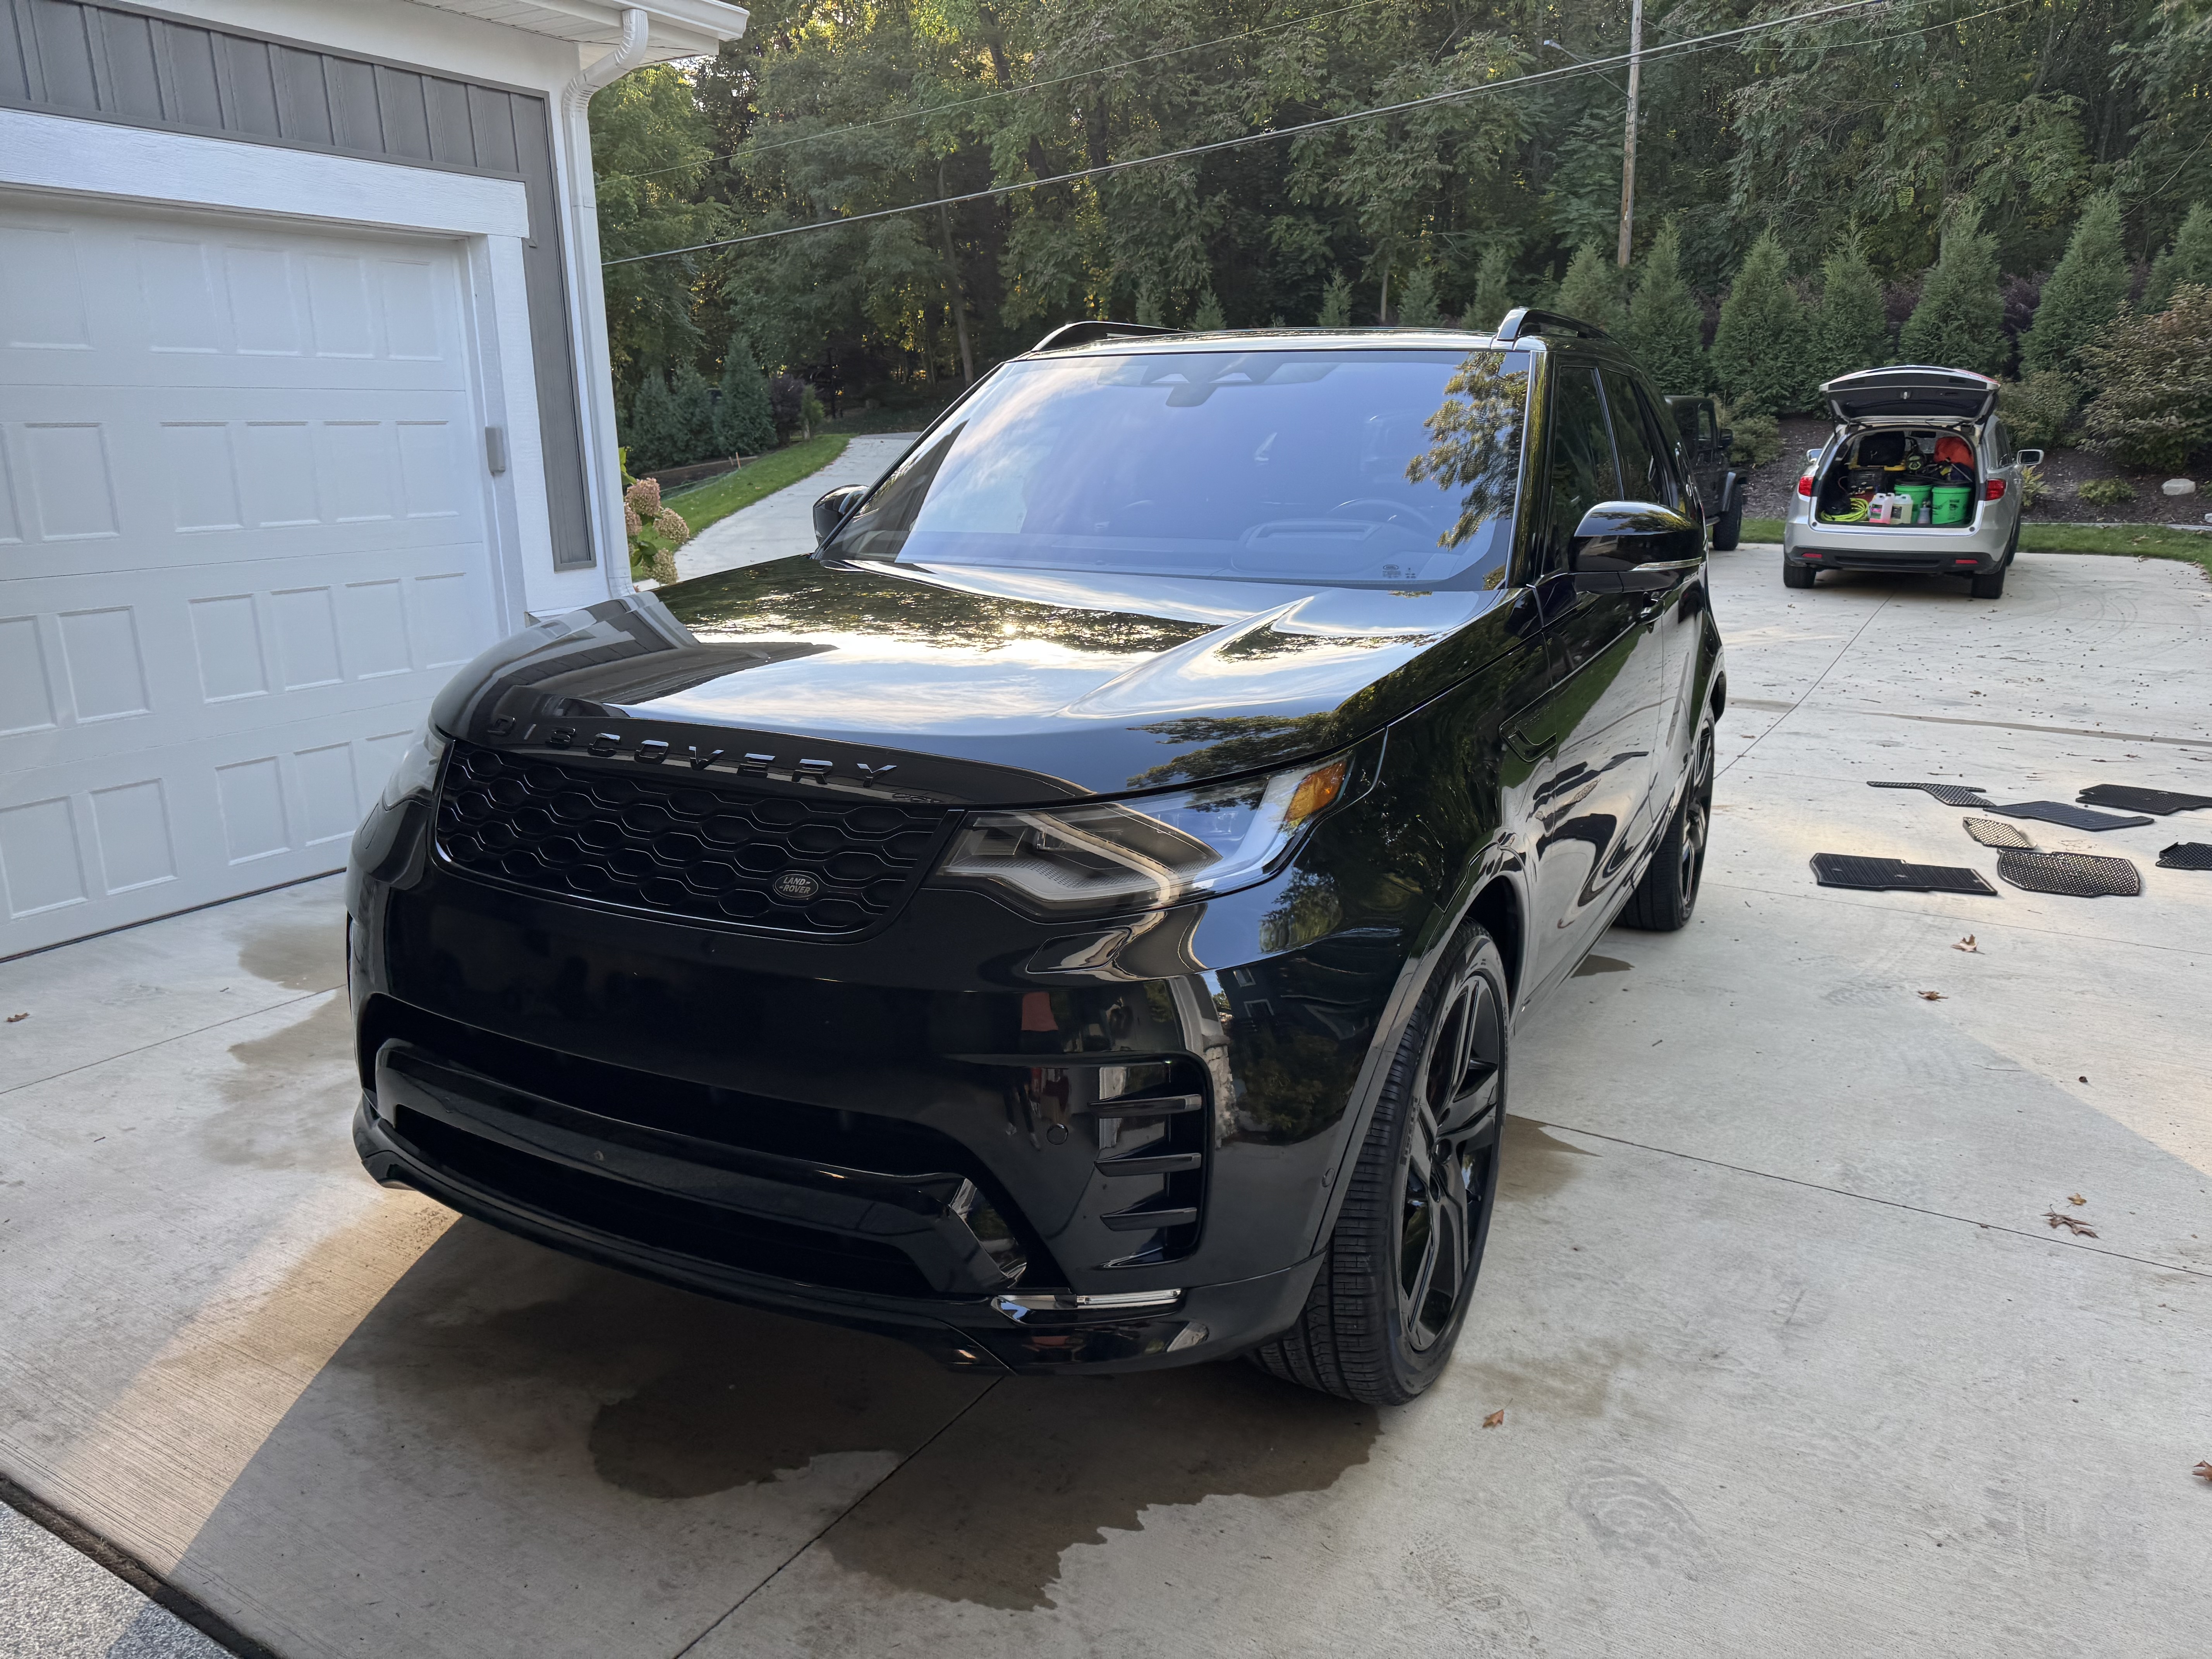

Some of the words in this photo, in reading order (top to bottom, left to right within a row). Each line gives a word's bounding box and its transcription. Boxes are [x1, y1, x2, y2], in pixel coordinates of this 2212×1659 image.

[487, 714, 897, 788] DISCOVERY
[783, 877, 806, 886] LAND
[783, 884, 811, 894] ROVER
